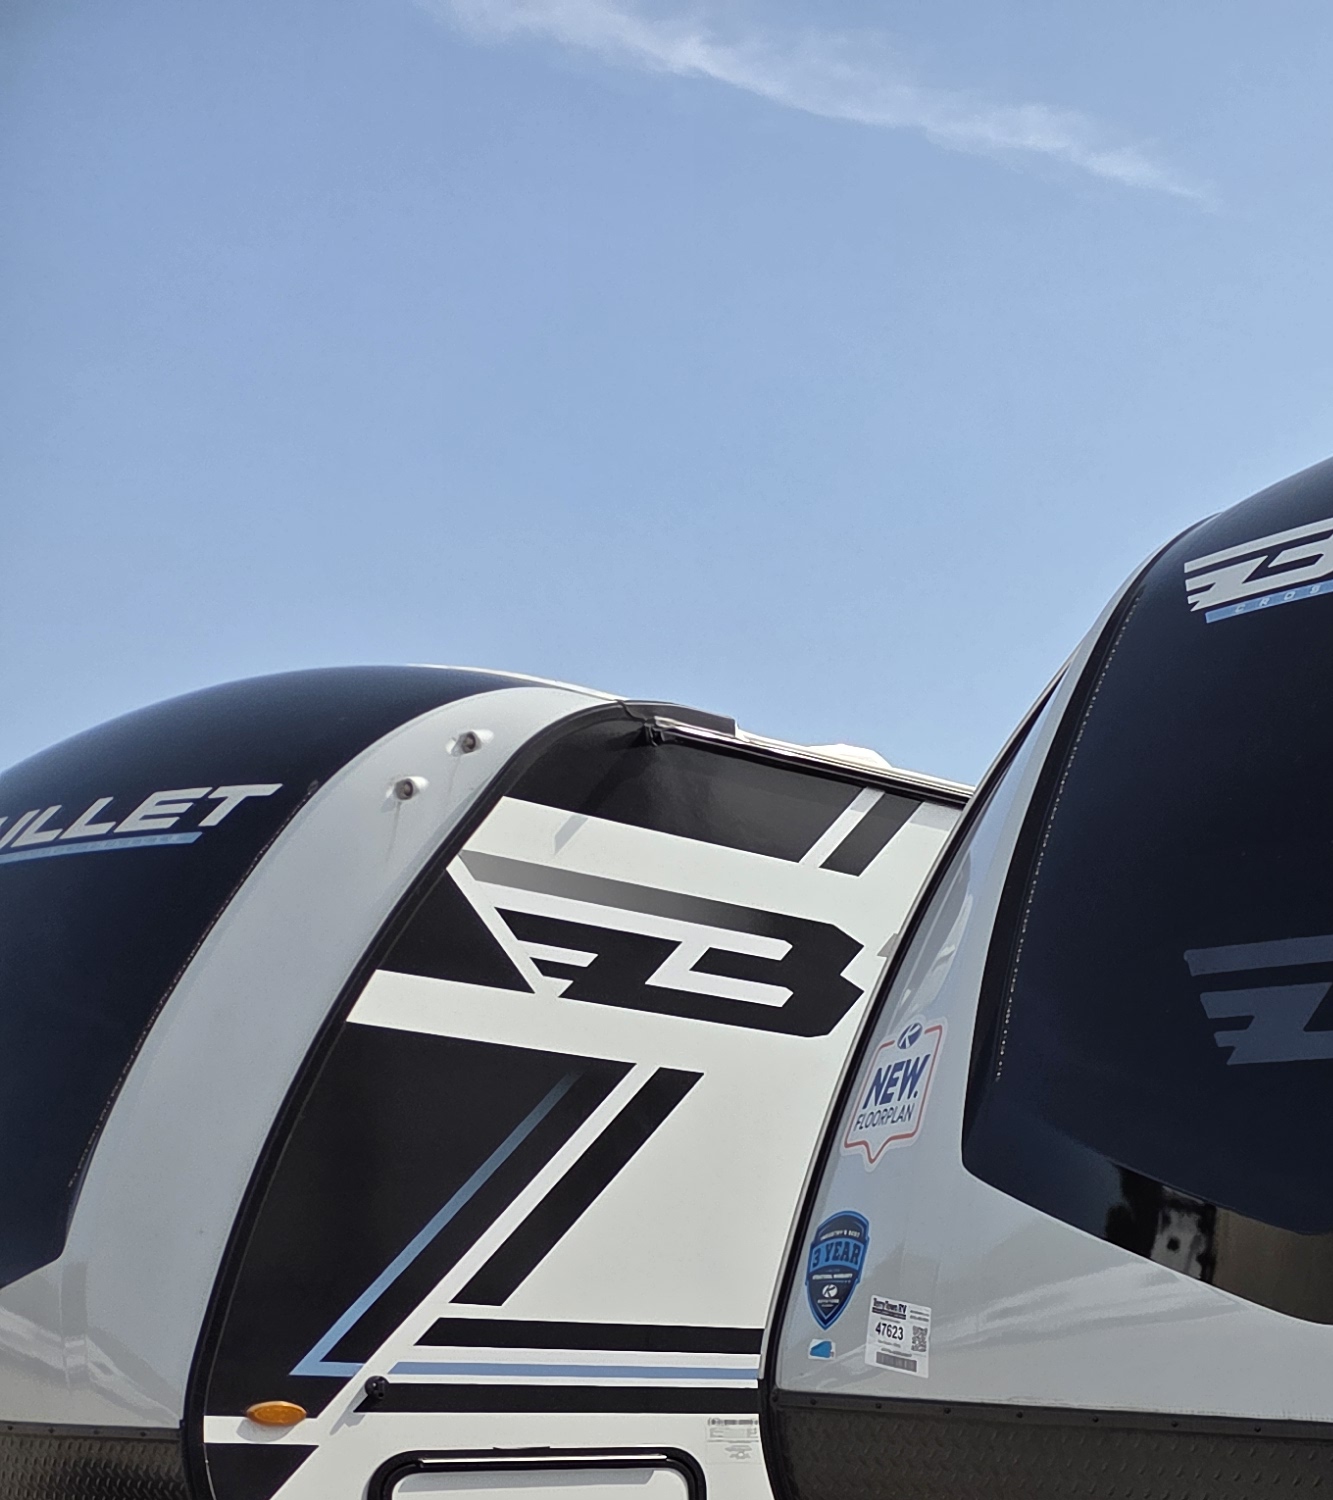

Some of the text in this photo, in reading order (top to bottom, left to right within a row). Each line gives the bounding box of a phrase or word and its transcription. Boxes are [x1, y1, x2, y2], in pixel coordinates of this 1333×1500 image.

[853, 1102, 915, 1131] FLOORPLAN
[812, 1241, 861, 1268] 3 YEAR
[875, 1321, 904, 1341] 47623
